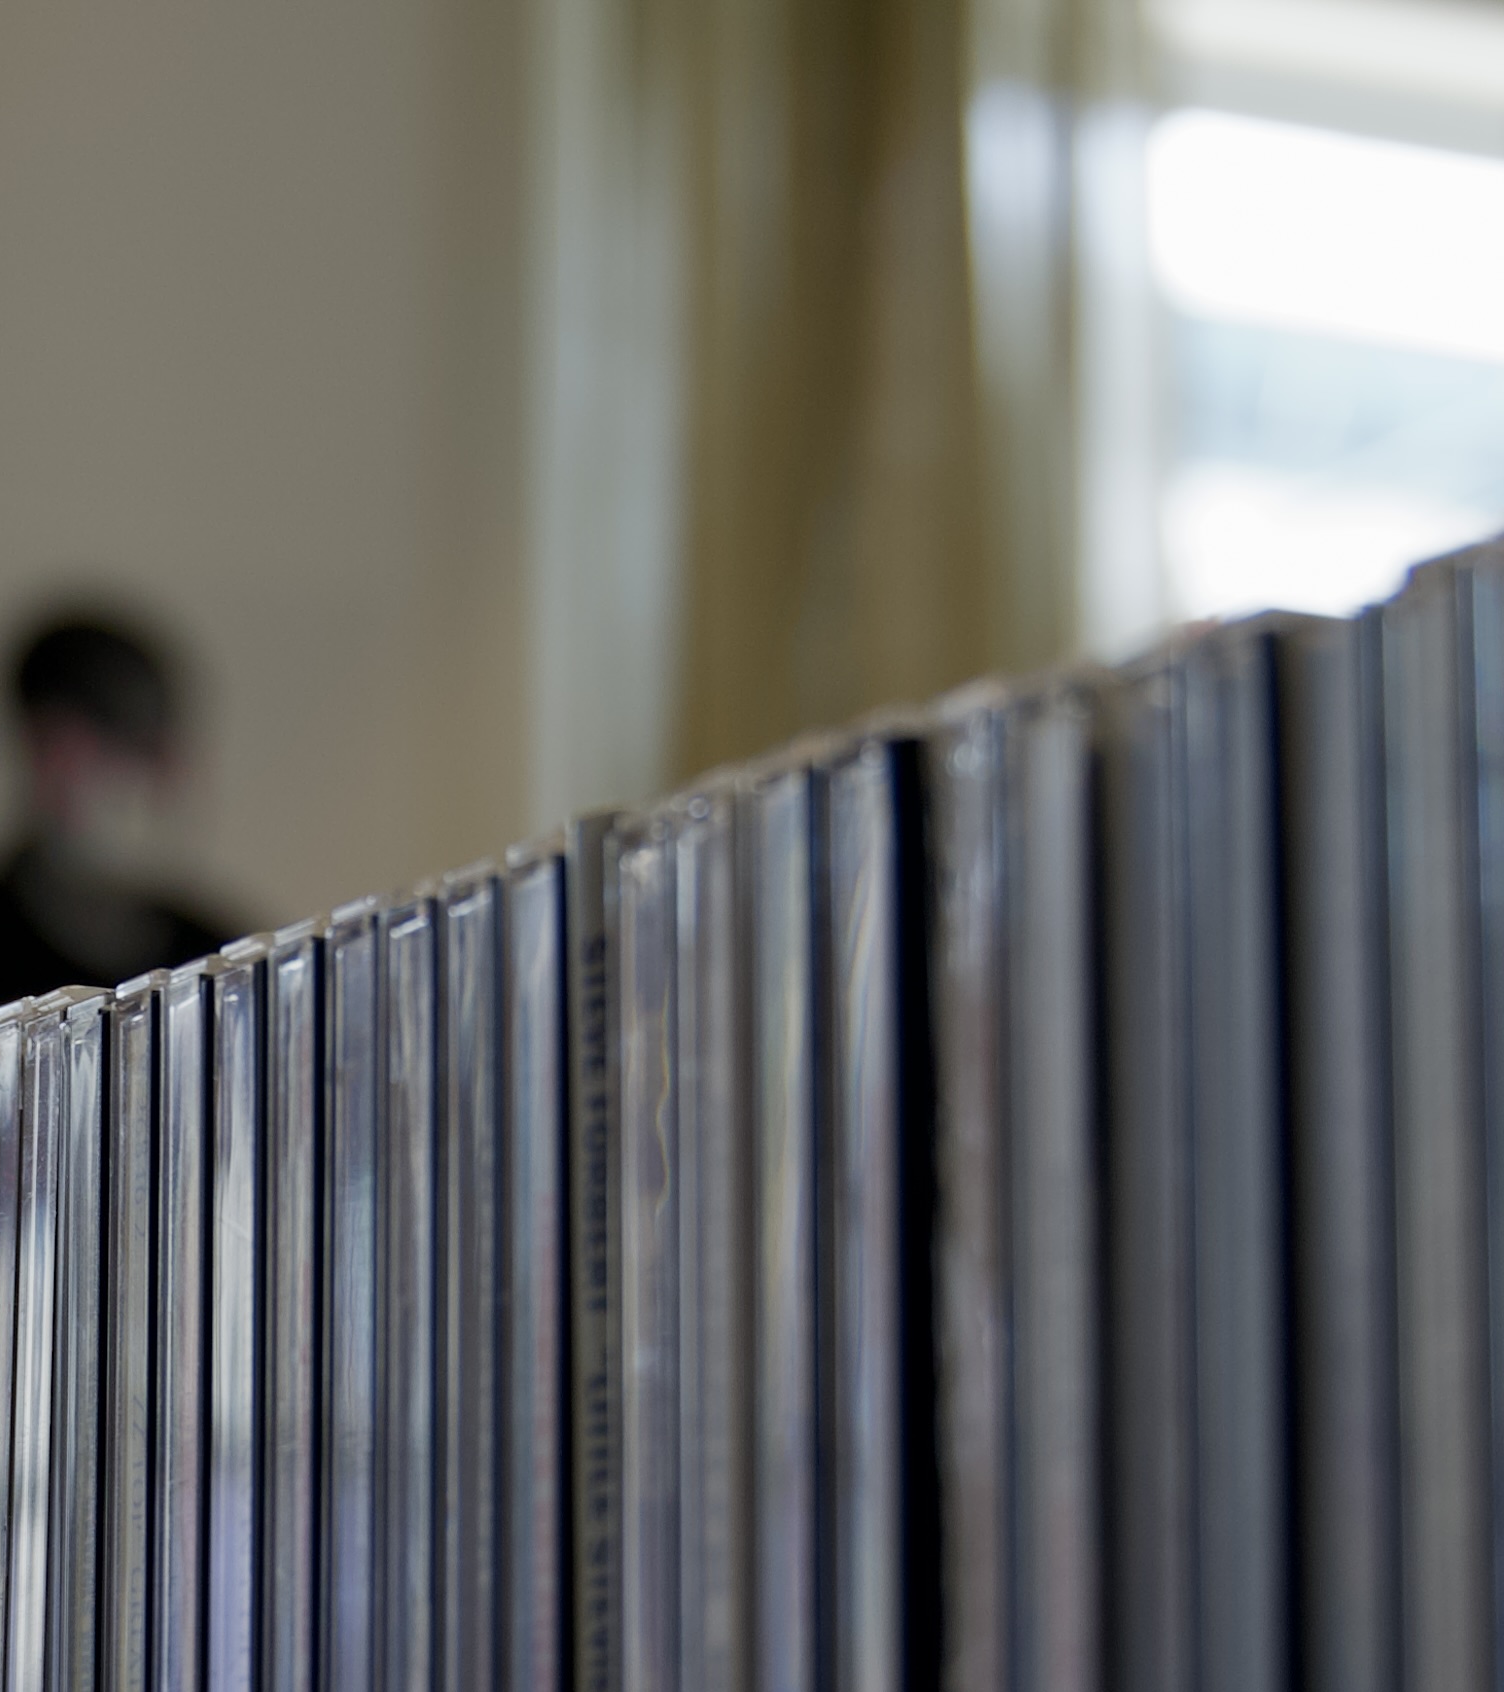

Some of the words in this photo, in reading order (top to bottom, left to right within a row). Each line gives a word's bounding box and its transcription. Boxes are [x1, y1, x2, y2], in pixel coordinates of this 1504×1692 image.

[582, 935, 610, 1078] STEVE
[131, 1393, 146, 1441] ZZ
[131, 1453, 146, 1532] TOP
